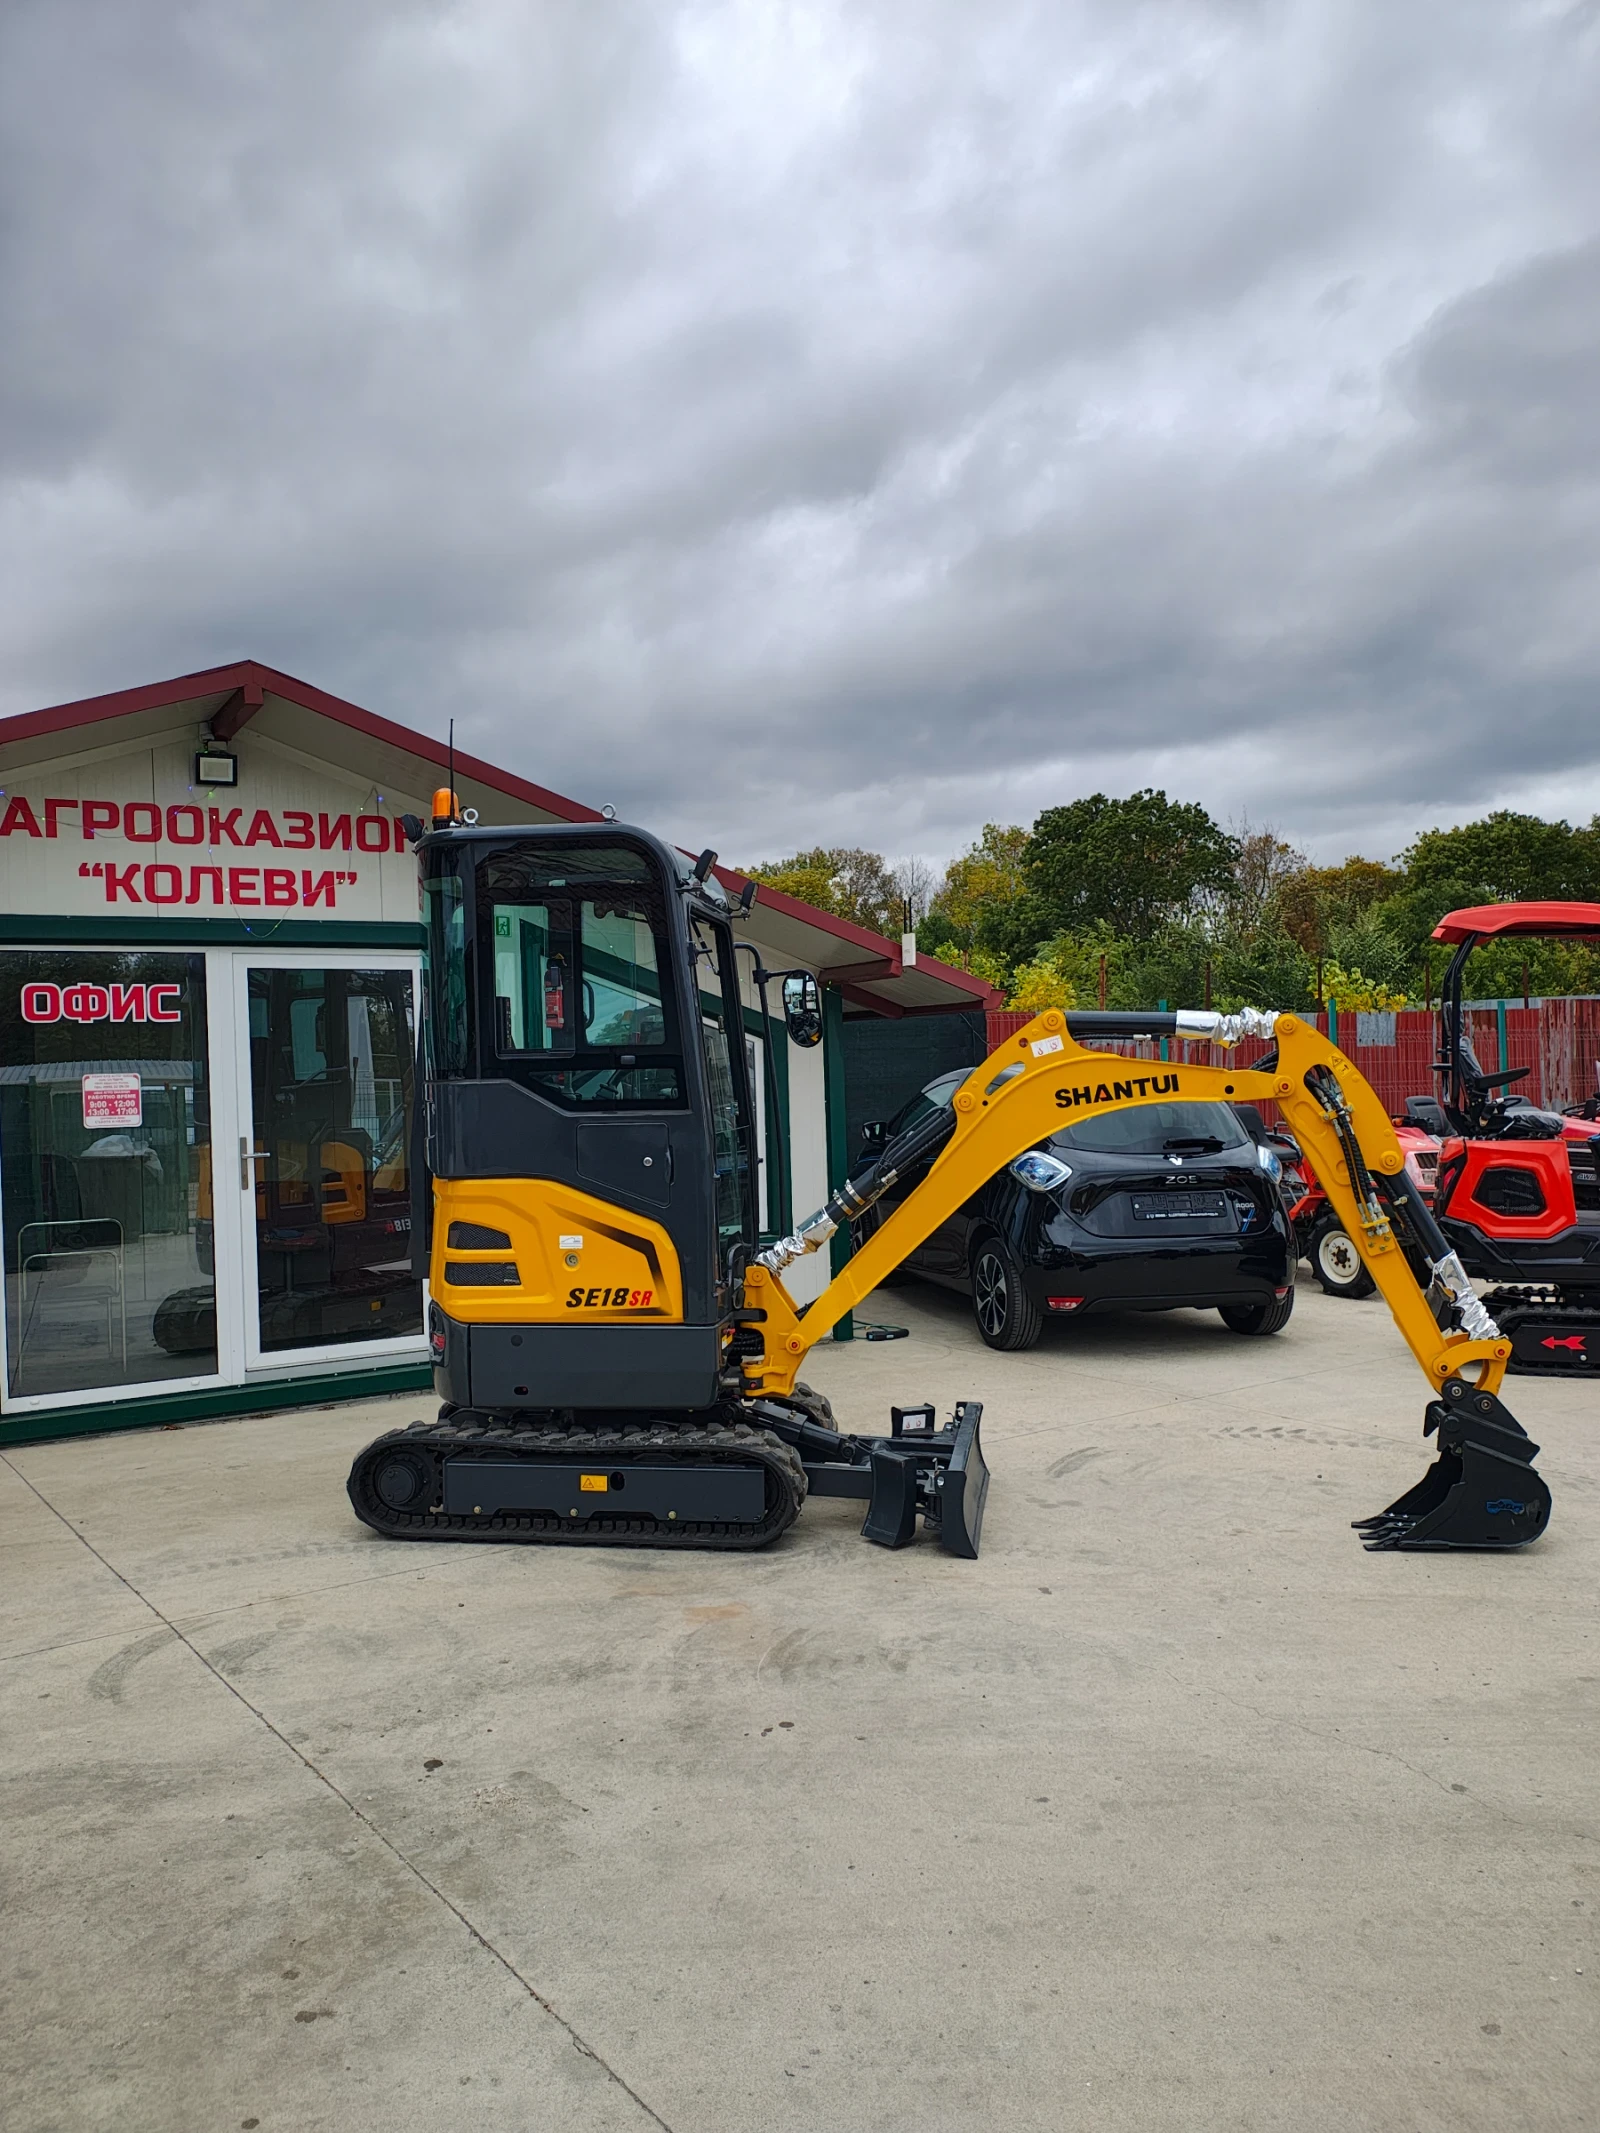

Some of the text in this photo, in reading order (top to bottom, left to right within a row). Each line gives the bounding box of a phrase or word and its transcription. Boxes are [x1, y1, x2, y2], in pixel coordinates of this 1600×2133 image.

[21, 982, 181, 1024] ОФИС
[1055, 1074, 1179, 1108] SHANTUI
[1165, 1175, 1198, 1184] ZOE
